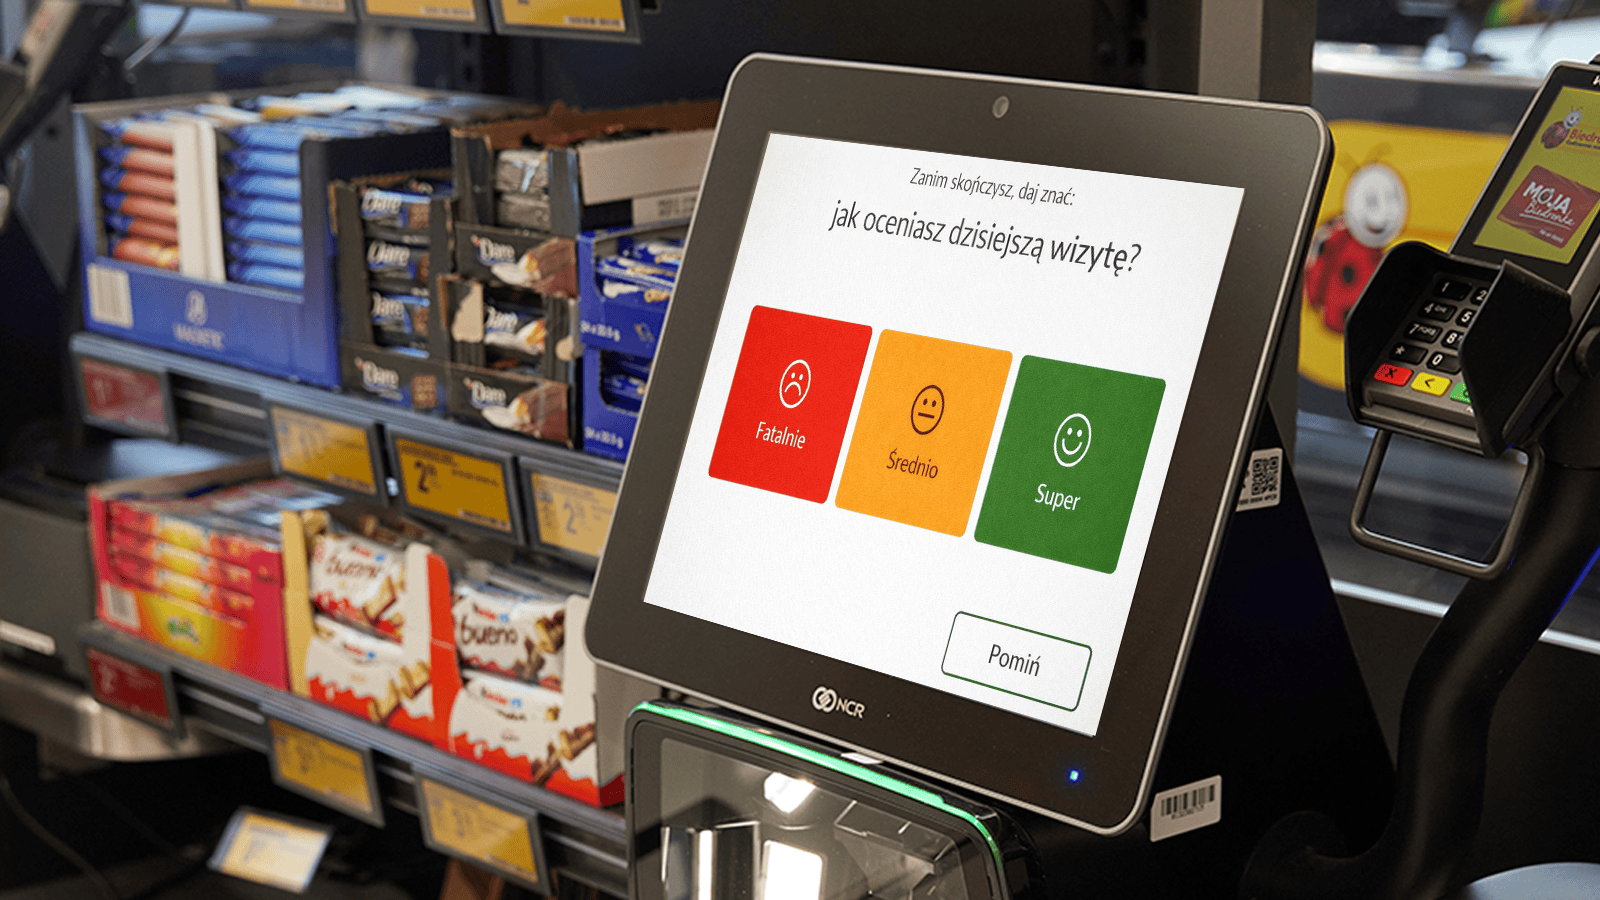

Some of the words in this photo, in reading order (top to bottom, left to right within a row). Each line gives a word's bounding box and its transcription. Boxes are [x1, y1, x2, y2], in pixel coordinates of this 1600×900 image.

[908, 167, 949, 189] Zanim
[950, 173, 1014, 200] skończysz,
[1018, 182, 1040, 205] daj
[1040, 187, 1076, 206] znać:
[1523, 181, 1571, 214] MOJA
[479, 237, 517, 266] Dare
[827, 199, 862, 232] jak
[863, 211, 947, 243] oceniasz
[949, 217, 1045, 266] dzisiejszą
[1050, 239, 1142, 278] wizytę?
[1424, 302, 1435, 315] 4
[1475, 289, 1488, 302] 2
[1408, 323, 1420, 335] 7
[1460, 310, 1473, 323] 5
[1446, 331, 1458, 344] 8
[1431, 353, 1444, 366] 0
[363, 360, 400, 391] Dare
[471, 380, 507, 407] Dare
[755, 420, 807, 450] Fatalnie
[885, 448, 940, 480] Średnio
[1034, 483, 1082, 512] Super
[460, 615, 519, 646] bueno
[987, 642, 1041, 677] Pomiń
[835, 697, 866, 719] NCR
